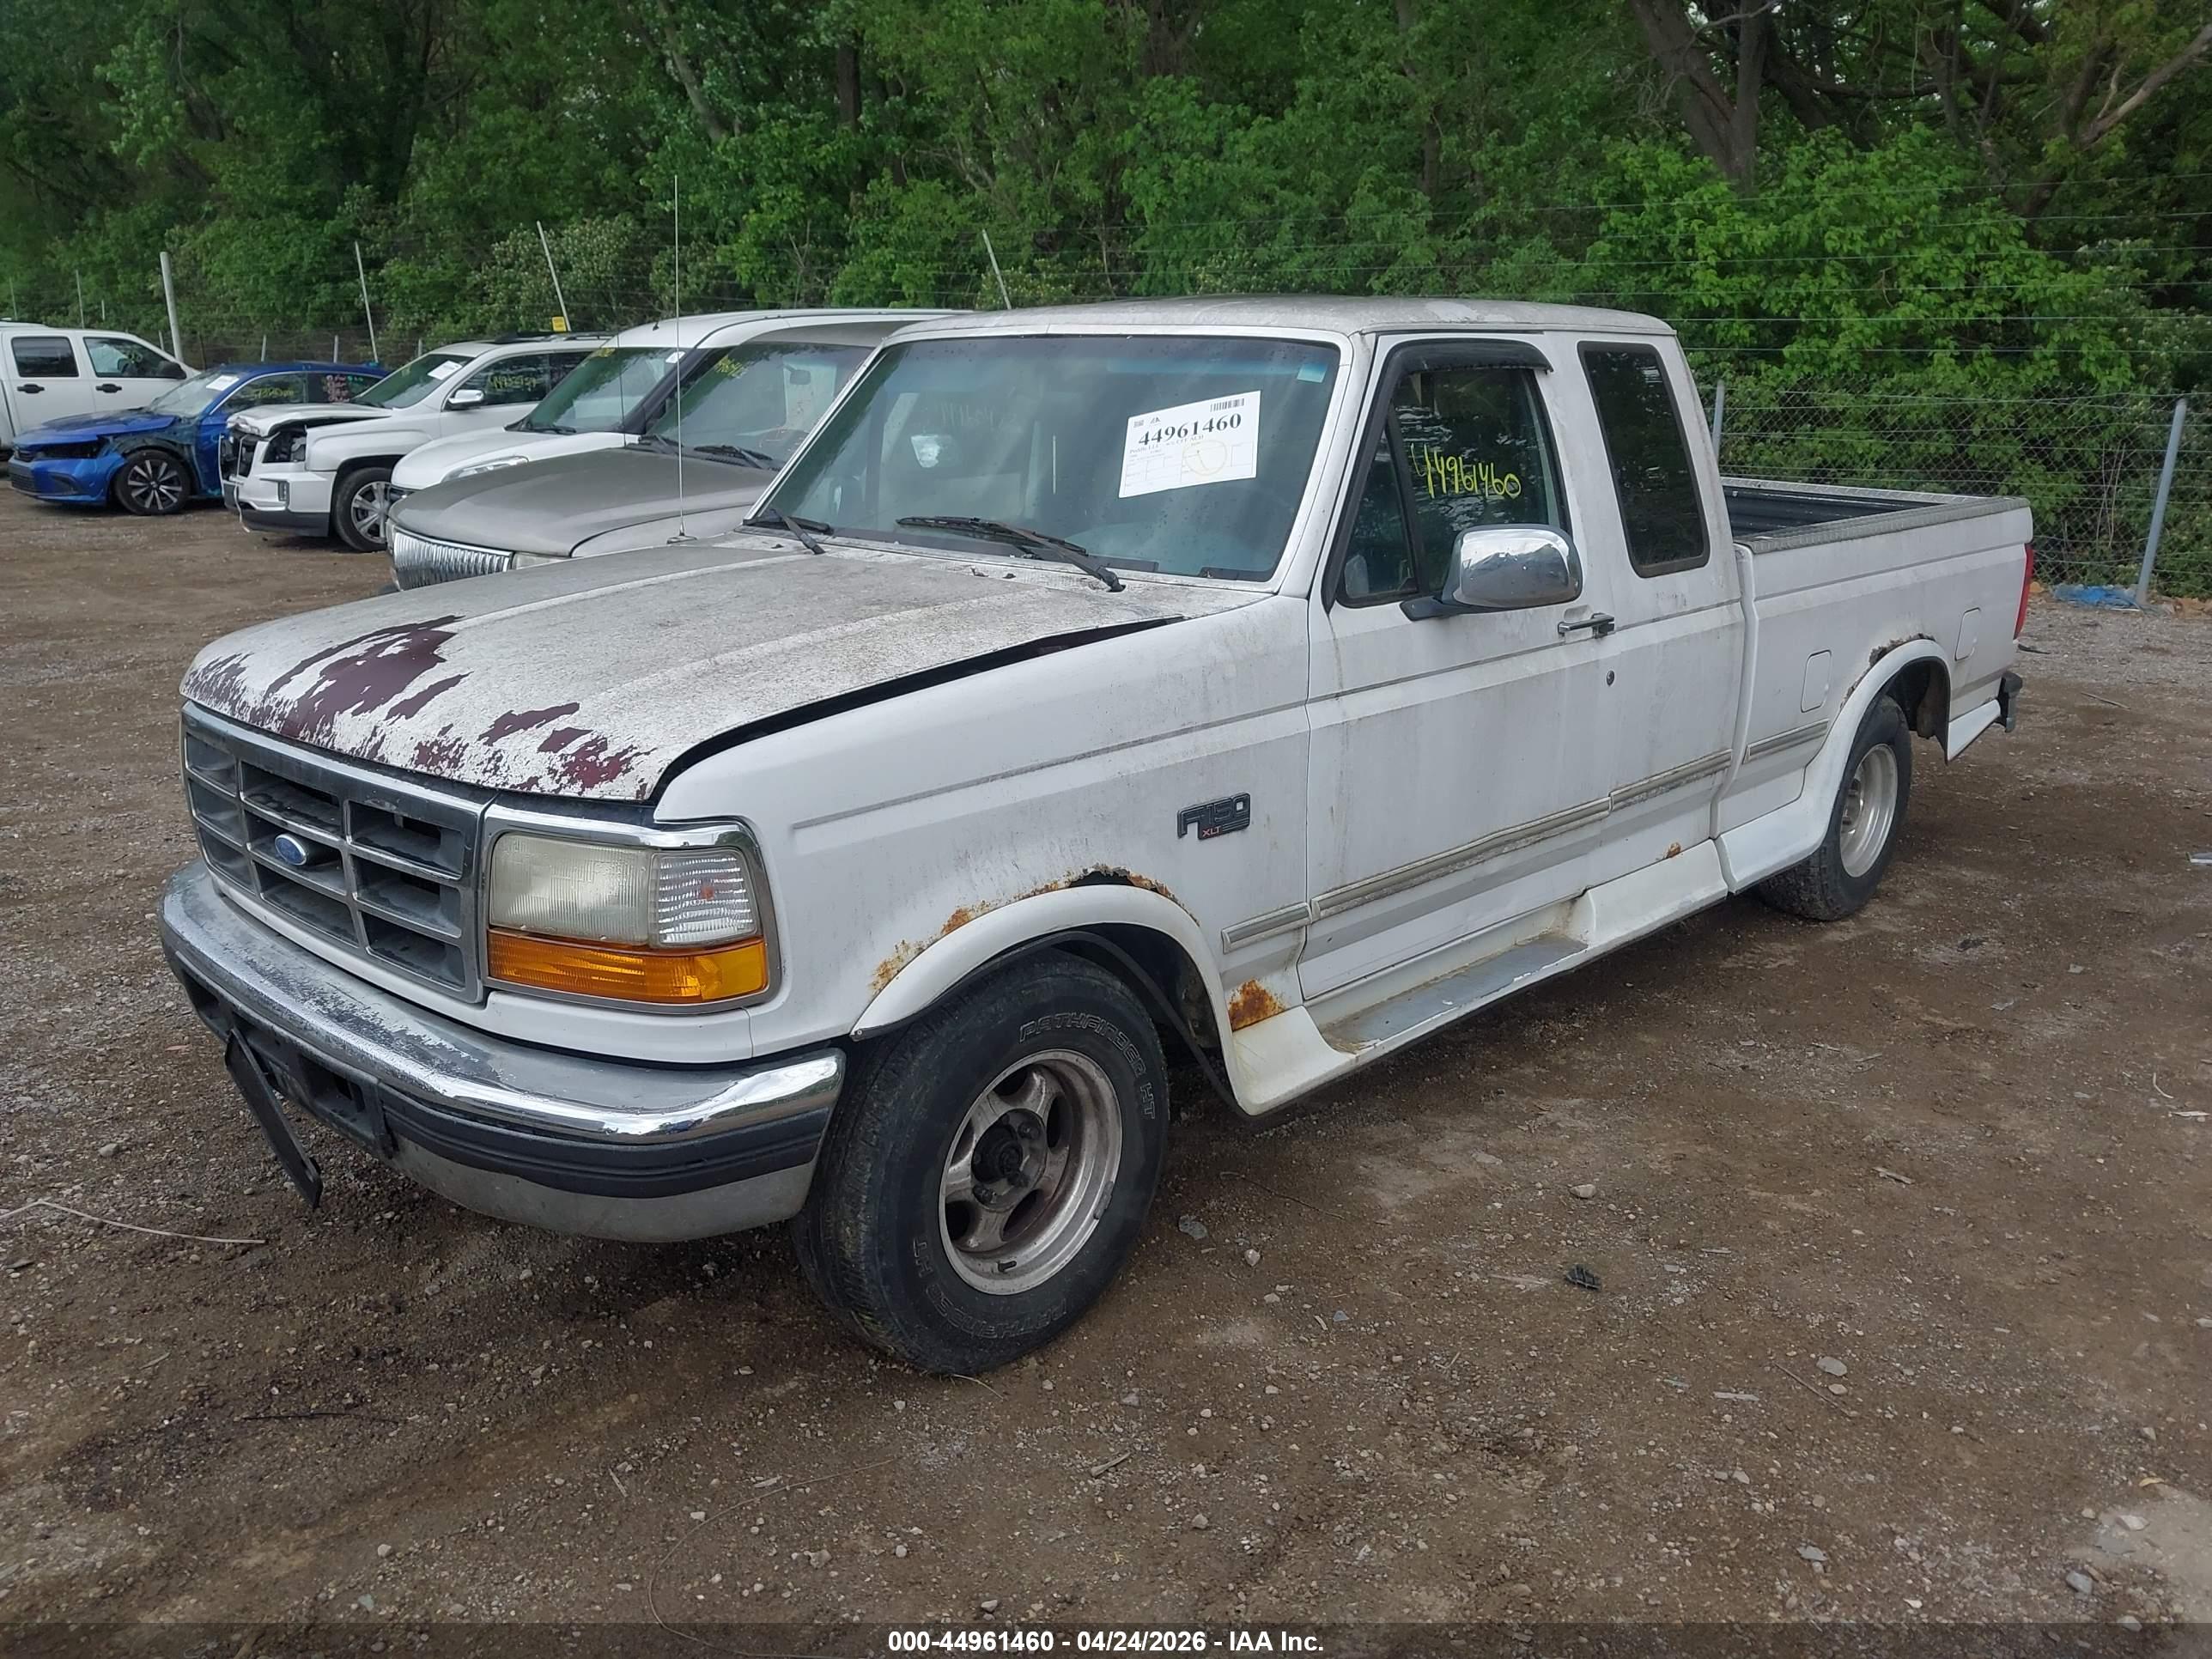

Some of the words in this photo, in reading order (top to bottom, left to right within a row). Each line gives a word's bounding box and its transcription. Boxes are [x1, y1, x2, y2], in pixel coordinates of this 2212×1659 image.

[1138, 413, 1243, 446] 44961460
[1410, 442, 1522, 499] 44961460
[1202, 825, 1220, 837] XLT
[1018, 1012, 1147, 1078] PATHFINDER
[1139, 1082, 1156, 1120] HT
